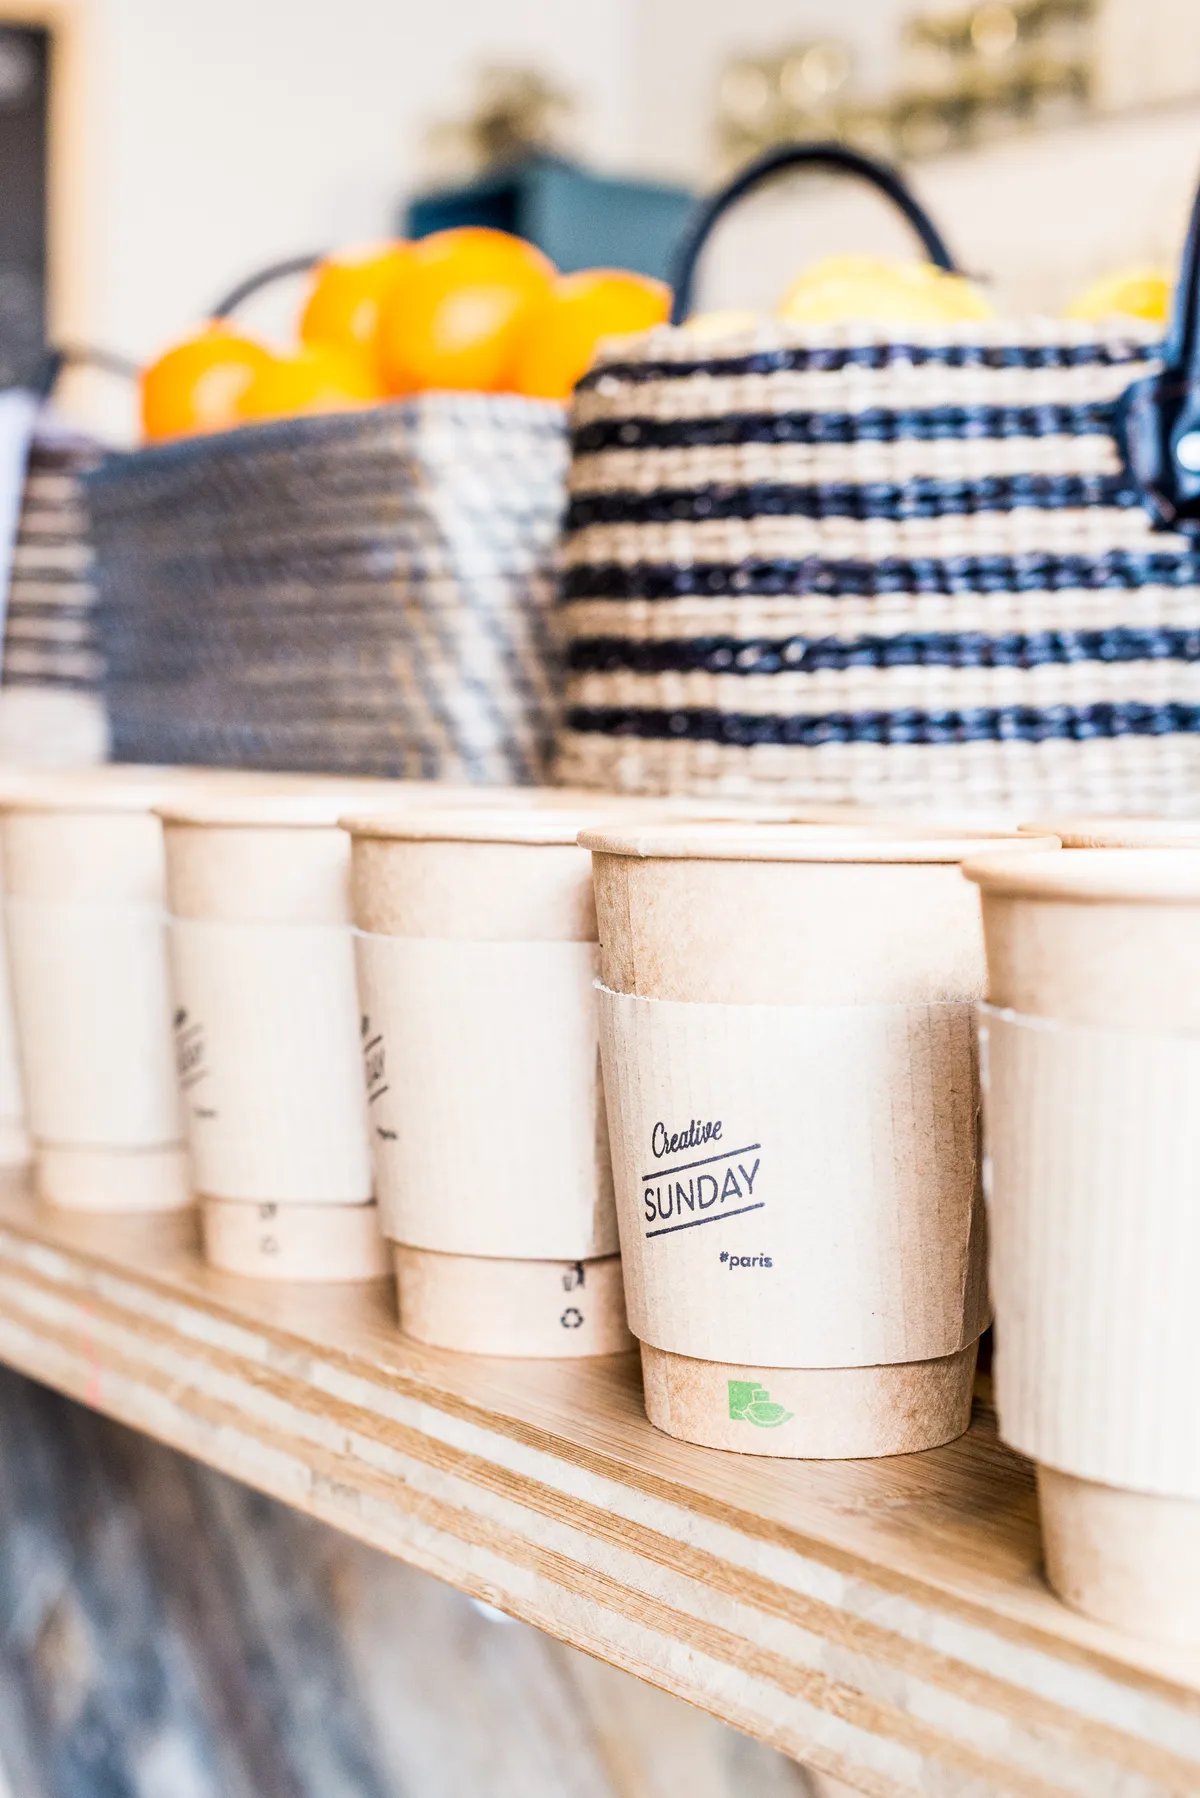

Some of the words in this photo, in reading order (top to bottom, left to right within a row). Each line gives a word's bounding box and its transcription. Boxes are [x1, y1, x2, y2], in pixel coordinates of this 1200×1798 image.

[652, 1119, 723, 1158] Creative
[644, 1158, 760, 1222] SUNDAY
[719, 1251, 773, 1270] #paris
